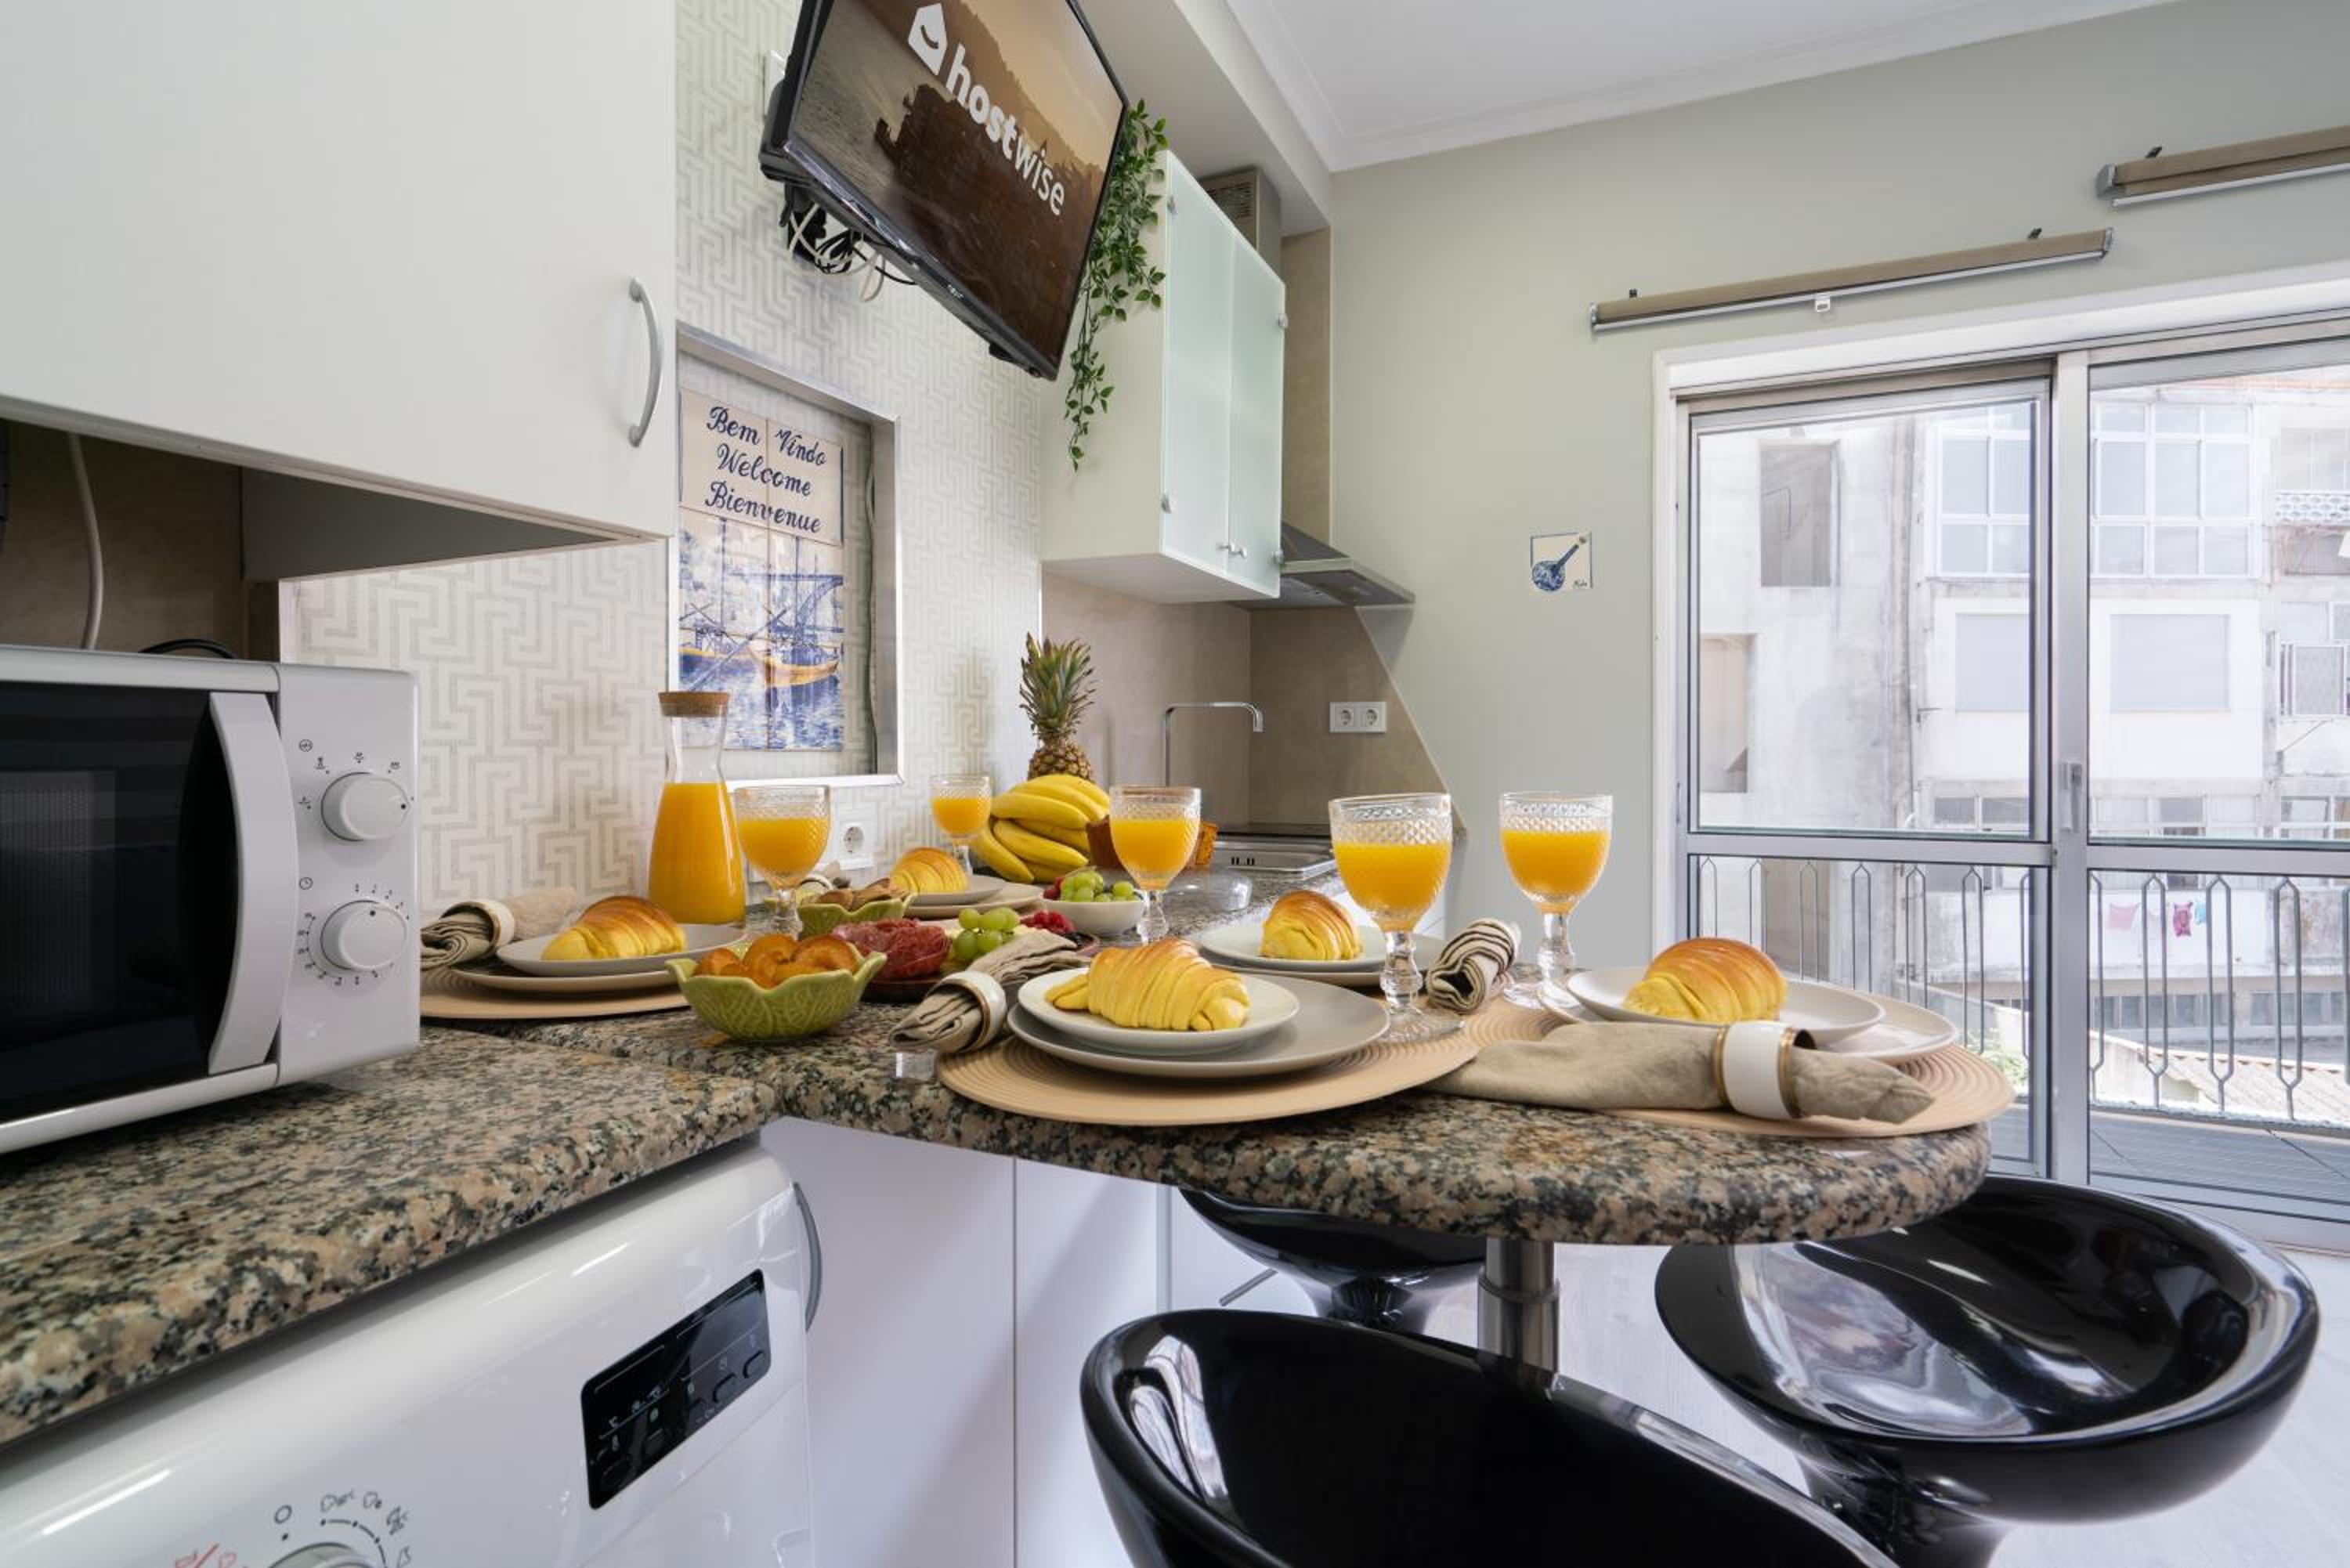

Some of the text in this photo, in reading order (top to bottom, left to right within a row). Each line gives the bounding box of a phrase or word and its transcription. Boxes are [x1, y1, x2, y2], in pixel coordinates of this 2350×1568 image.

[945, 44, 1065, 215] hostwise
[707, 406, 826, 466] Bem Vindo
[716, 443, 812, 497] Welcome
[705, 480, 822, 534] Bienvenue
